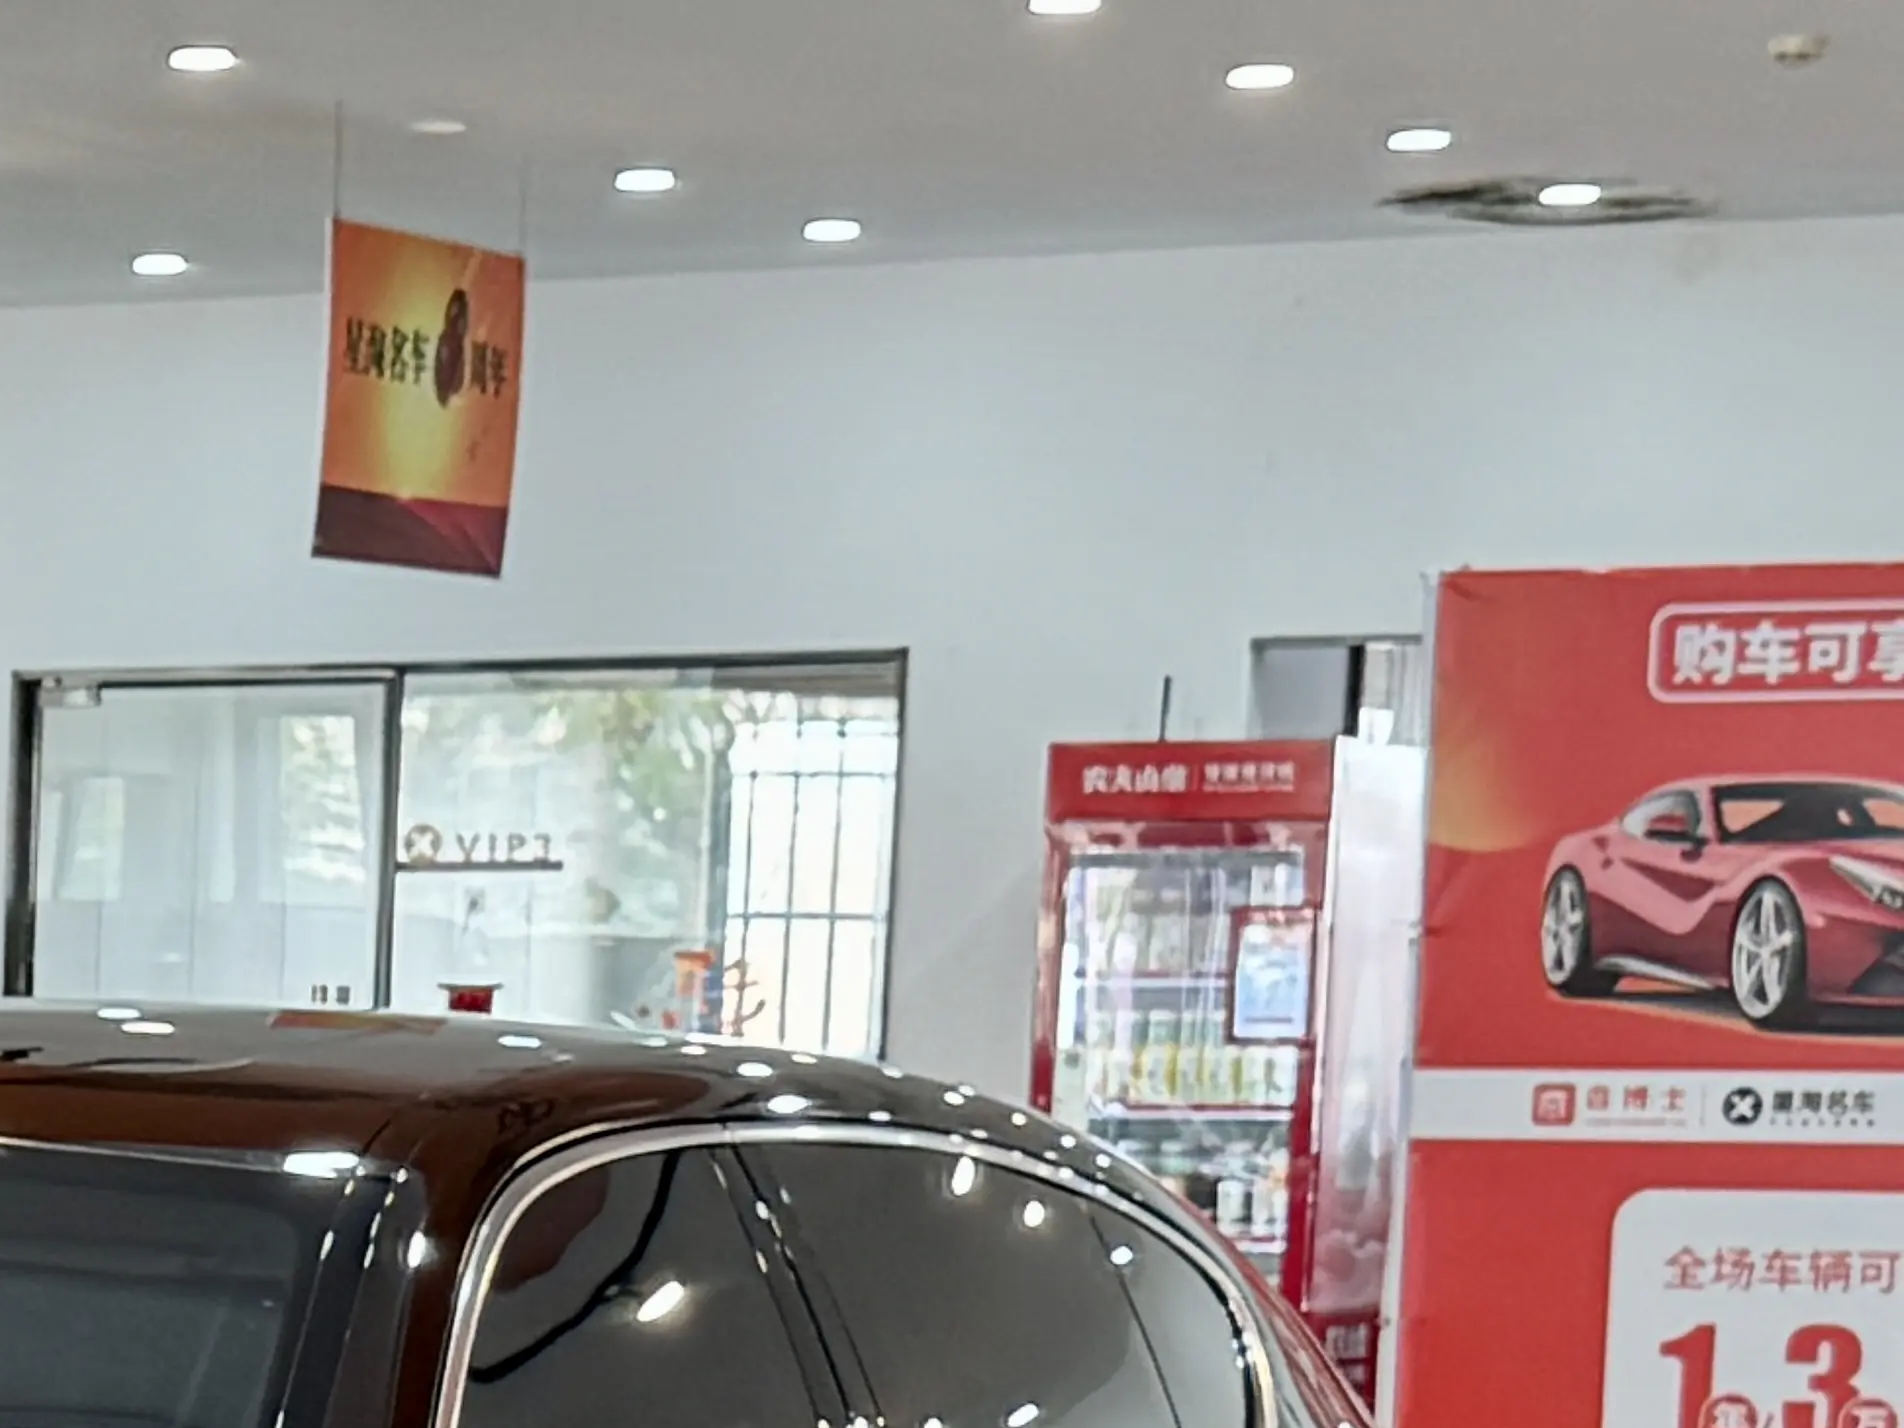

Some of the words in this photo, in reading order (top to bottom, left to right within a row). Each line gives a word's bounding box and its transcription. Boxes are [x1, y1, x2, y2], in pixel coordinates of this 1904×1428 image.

[1663, 1245, 1901, 1295] 全场车辆可
